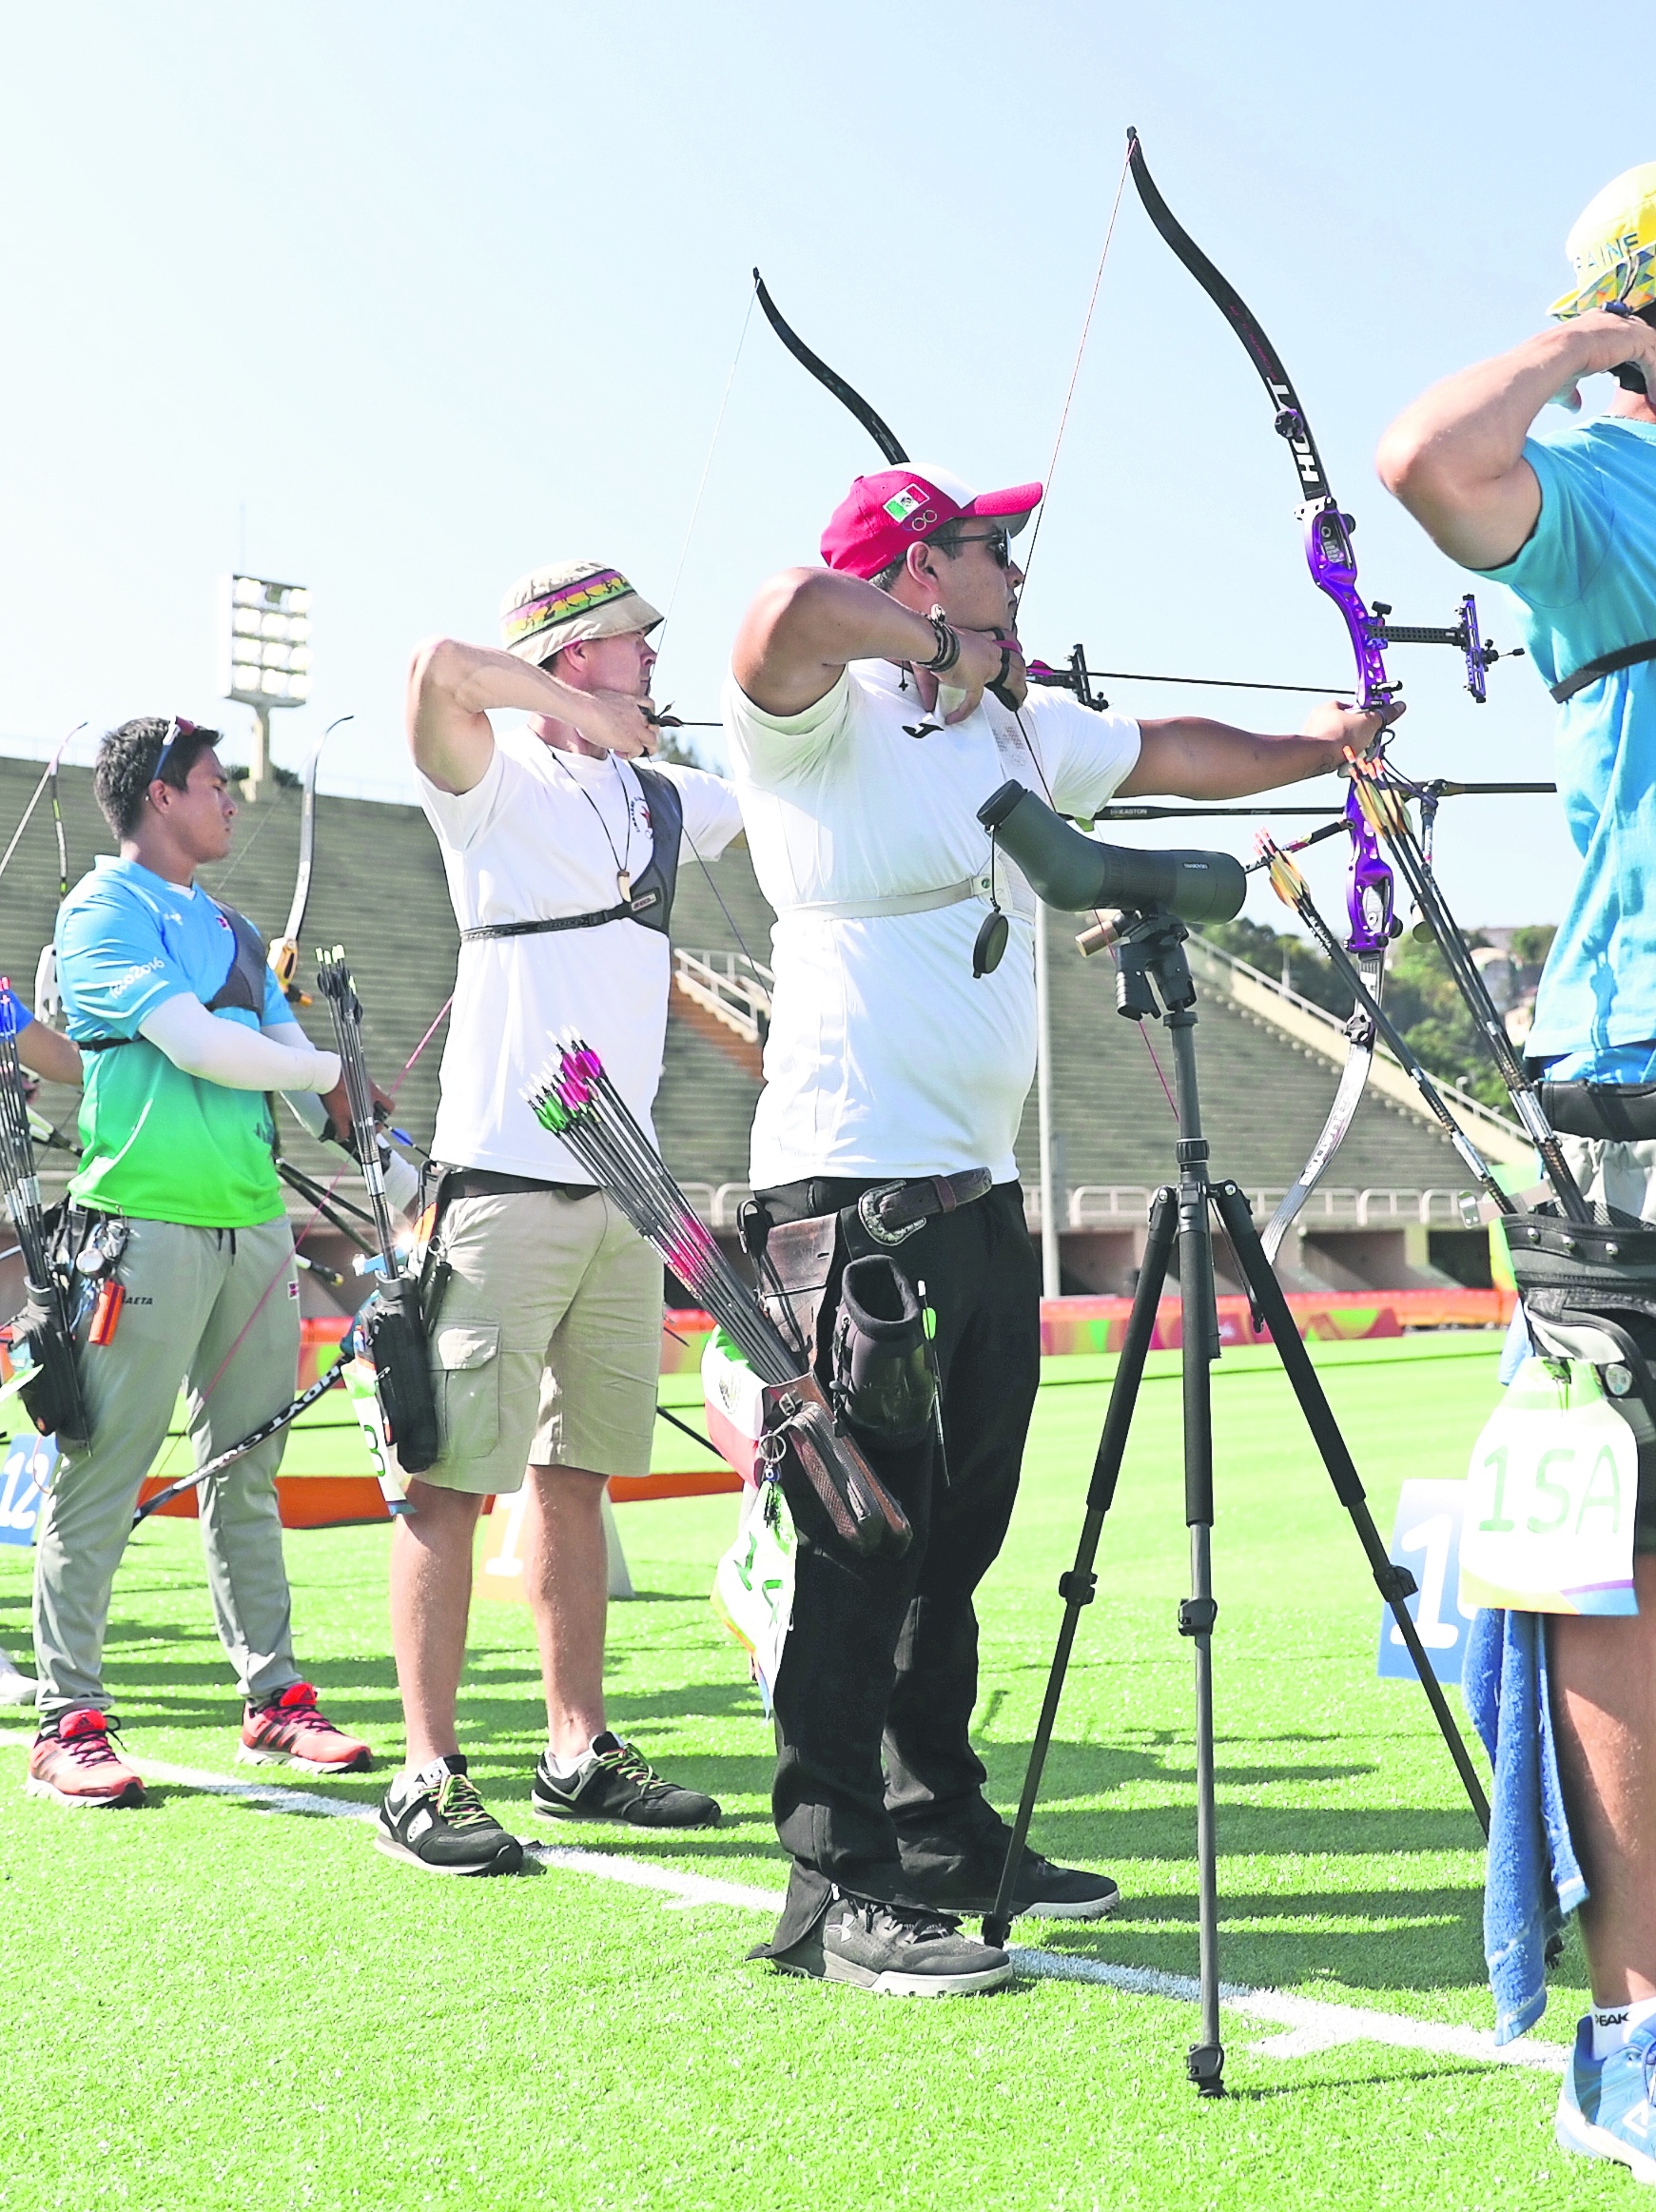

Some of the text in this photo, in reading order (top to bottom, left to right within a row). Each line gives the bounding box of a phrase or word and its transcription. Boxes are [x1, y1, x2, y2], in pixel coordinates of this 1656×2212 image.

[122, 1297, 153, 1305] AETA
[269, 1365, 341, 1432] HOYT
[0, 1452, 49, 1530] 12
[1479, 1444, 1621, 1536] 15A
[1390, 1514, 1475, 1650] 1
